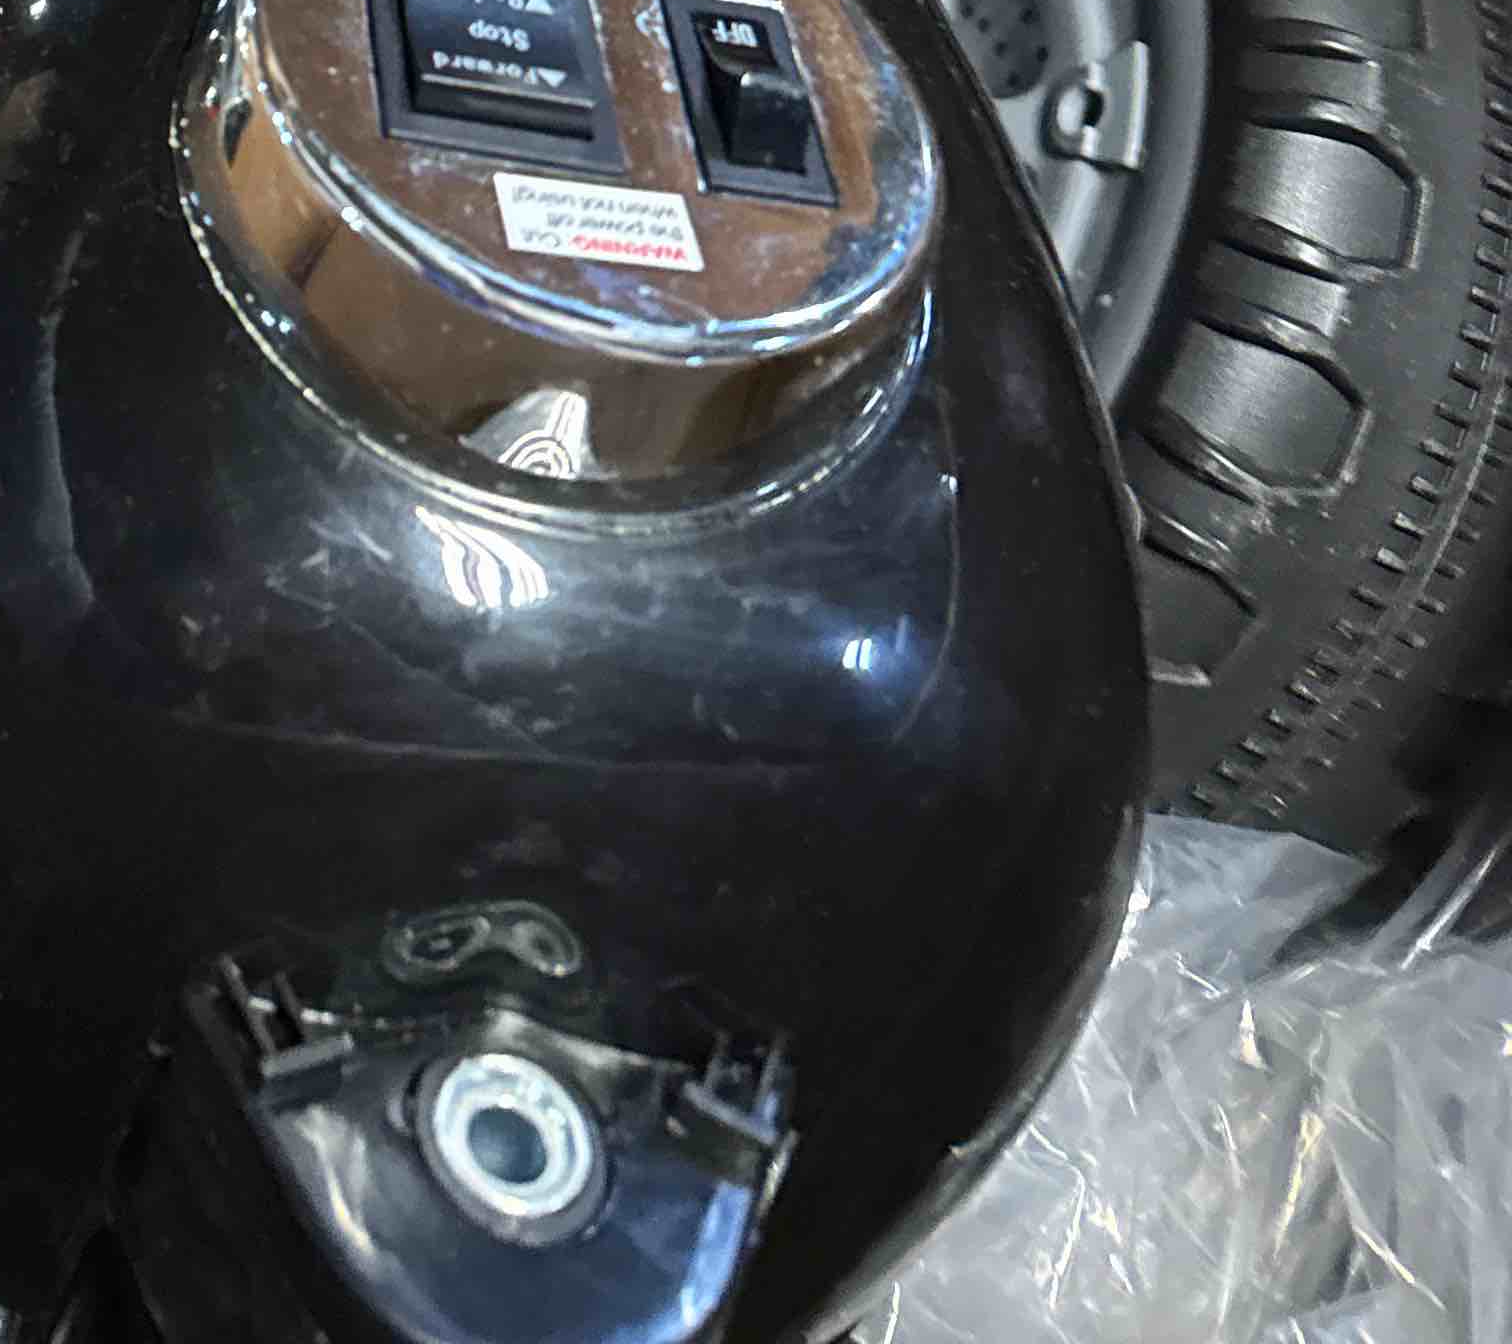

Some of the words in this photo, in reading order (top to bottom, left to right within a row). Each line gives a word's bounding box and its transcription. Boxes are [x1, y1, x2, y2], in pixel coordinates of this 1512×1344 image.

[468, 19, 530, 52] Stop
[711, 20, 757, 48] OFF
[433, 51, 538, 85] Forward
